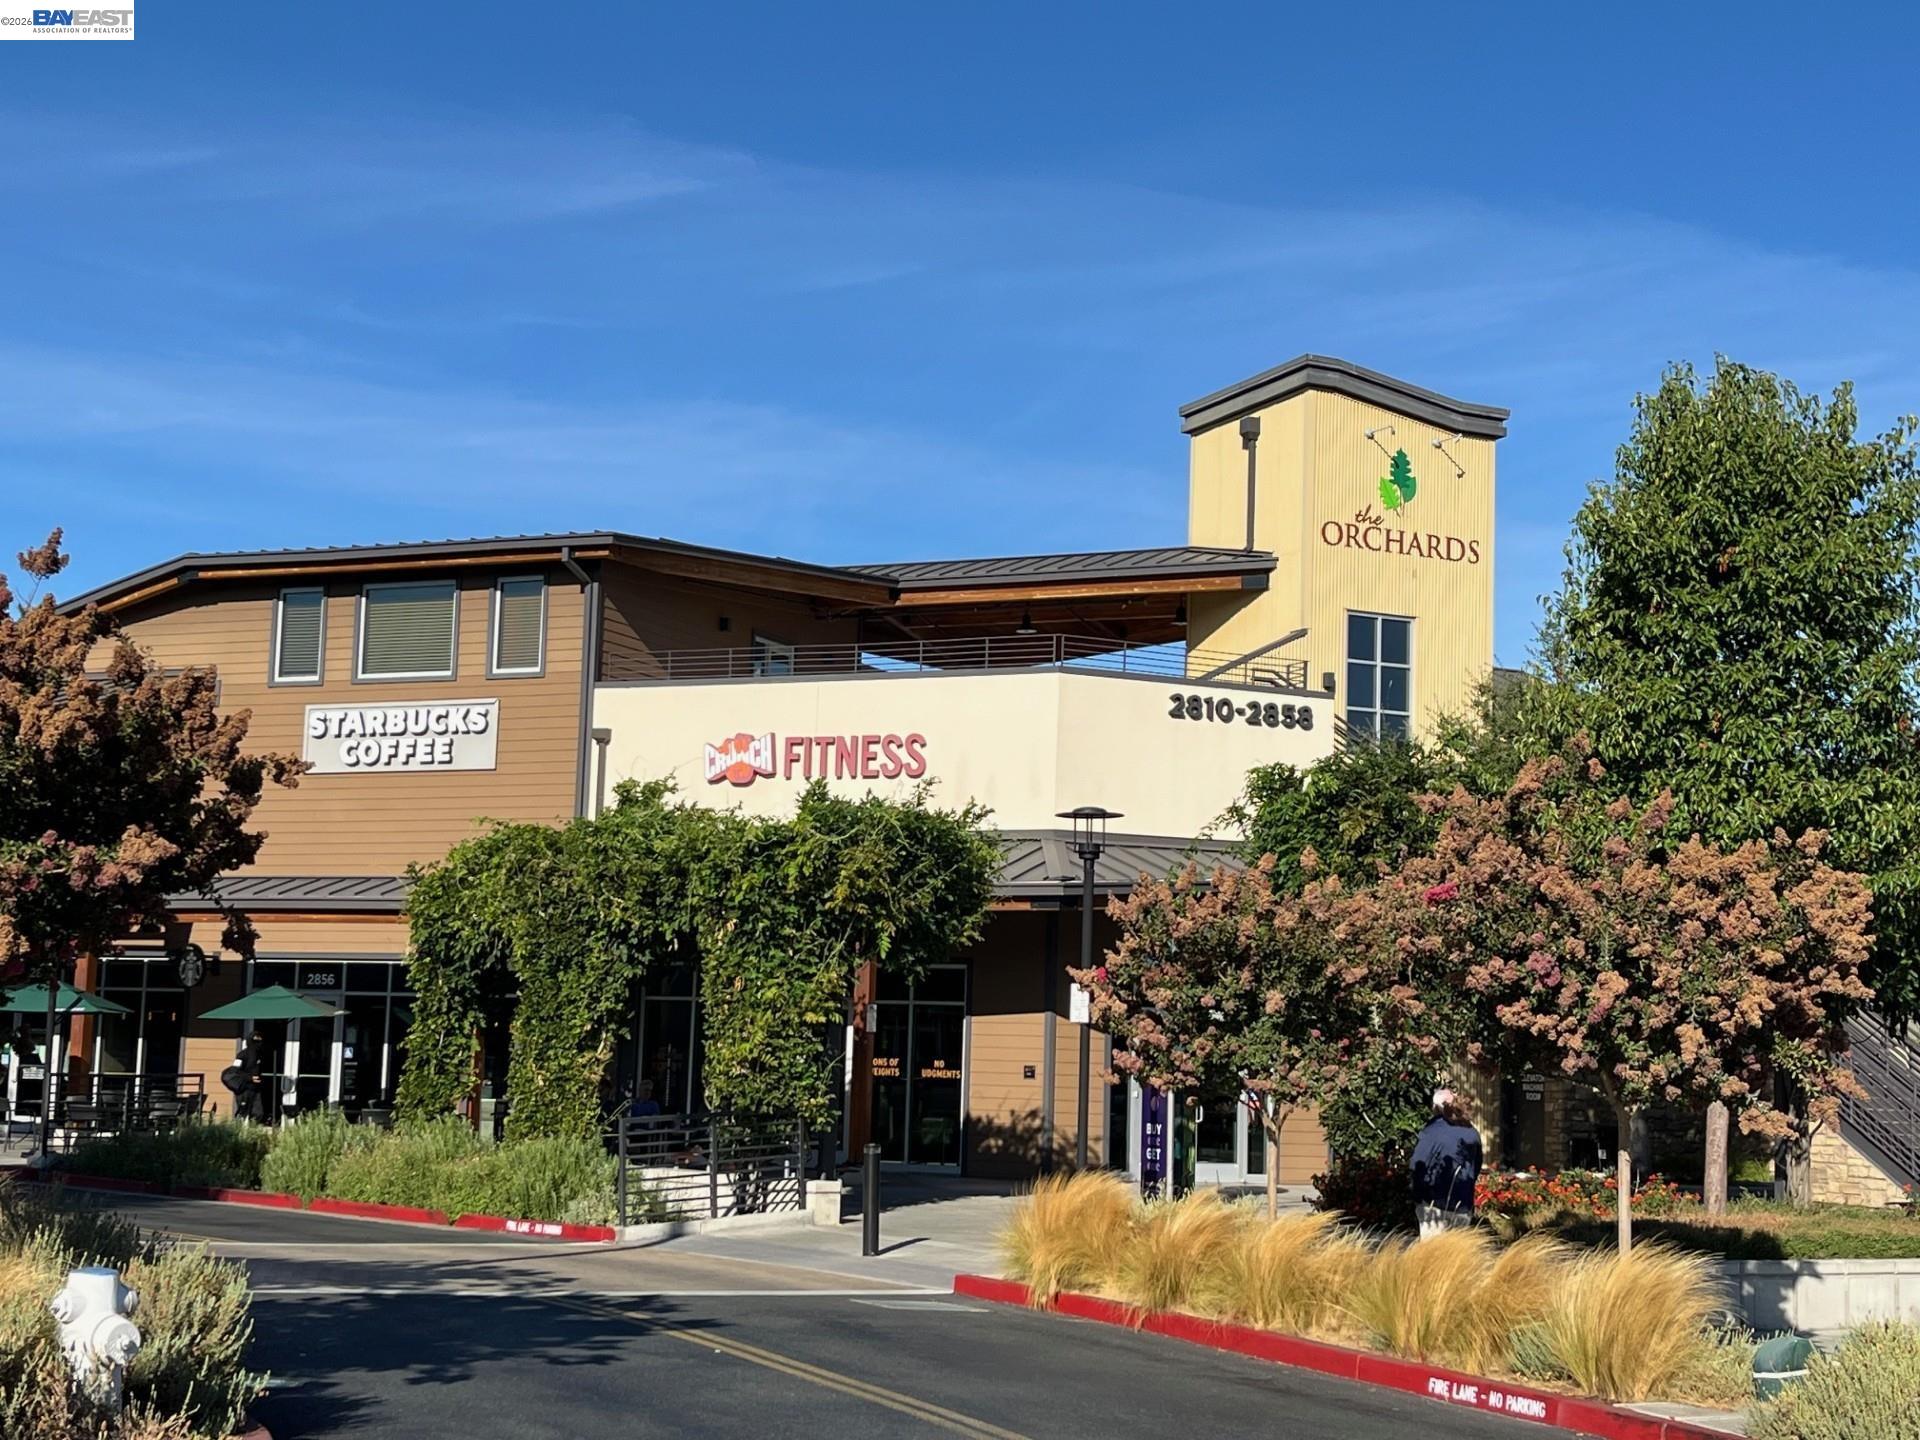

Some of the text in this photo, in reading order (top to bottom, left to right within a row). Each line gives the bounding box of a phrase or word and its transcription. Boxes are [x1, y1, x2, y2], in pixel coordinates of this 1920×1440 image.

[1355, 504, 1384, 526] the
[1321, 521, 1480, 564] ORCHARDS
[309, 706, 489, 739] STARBUCKS
[1168, 693, 1313, 730] 2810-2858
[339, 737, 454, 767] COFFEE
[704, 733, 927, 782] CRUNCH FITNESS
[307, 973, 335, 985] 2856
[872, 1057, 900, 1067] ONS OF
[872, 1067, 900, 1077] EIGHTS
[933, 1060, 945, 1068] NO
[1146, 1123, 1162, 1135] BUY
[1146, 1148, 1161, 1160] GET
[1428, 1377, 1450, 1398] FIRE
[1452, 1382, 1478, 1404] LANE
[1488, 1390, 1503, 1408] NO
[1505, 1395, 1546, 1418] PARKING
